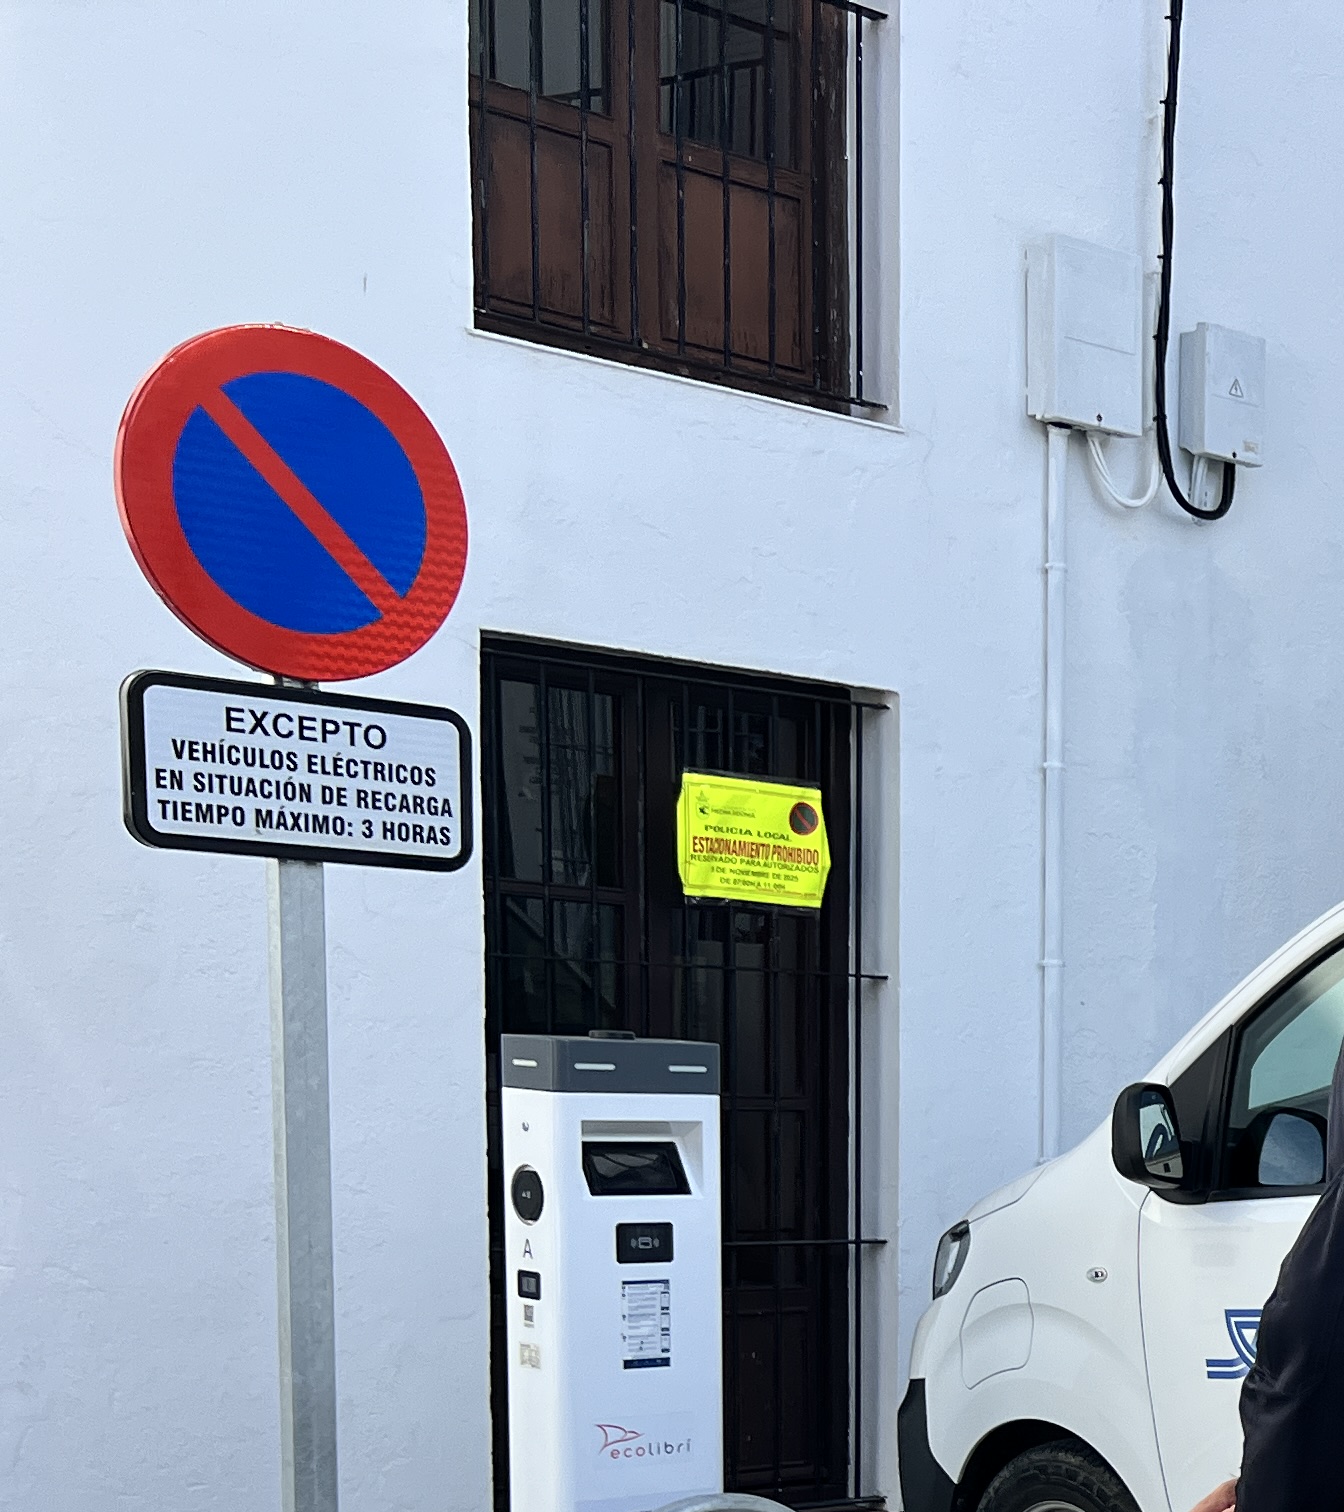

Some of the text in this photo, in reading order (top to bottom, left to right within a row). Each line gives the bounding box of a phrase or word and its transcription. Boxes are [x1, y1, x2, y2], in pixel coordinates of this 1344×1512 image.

[224, 706, 387, 749] EXCEPTO
[172, 738, 436, 788] VEHÍCULOS ELÉCTRICOS
[155, 768, 453, 818] EN SITUACIÓN DE RECARGA
[157, 799, 451, 846] TIEMPO MÁXIMO: 3 HORAS
[757, 830, 791, 842] LOCAL
[692, 835, 819, 866] ESTACIONAMIENTO PROHIBIDO
[740, 857, 762, 867] PARA
